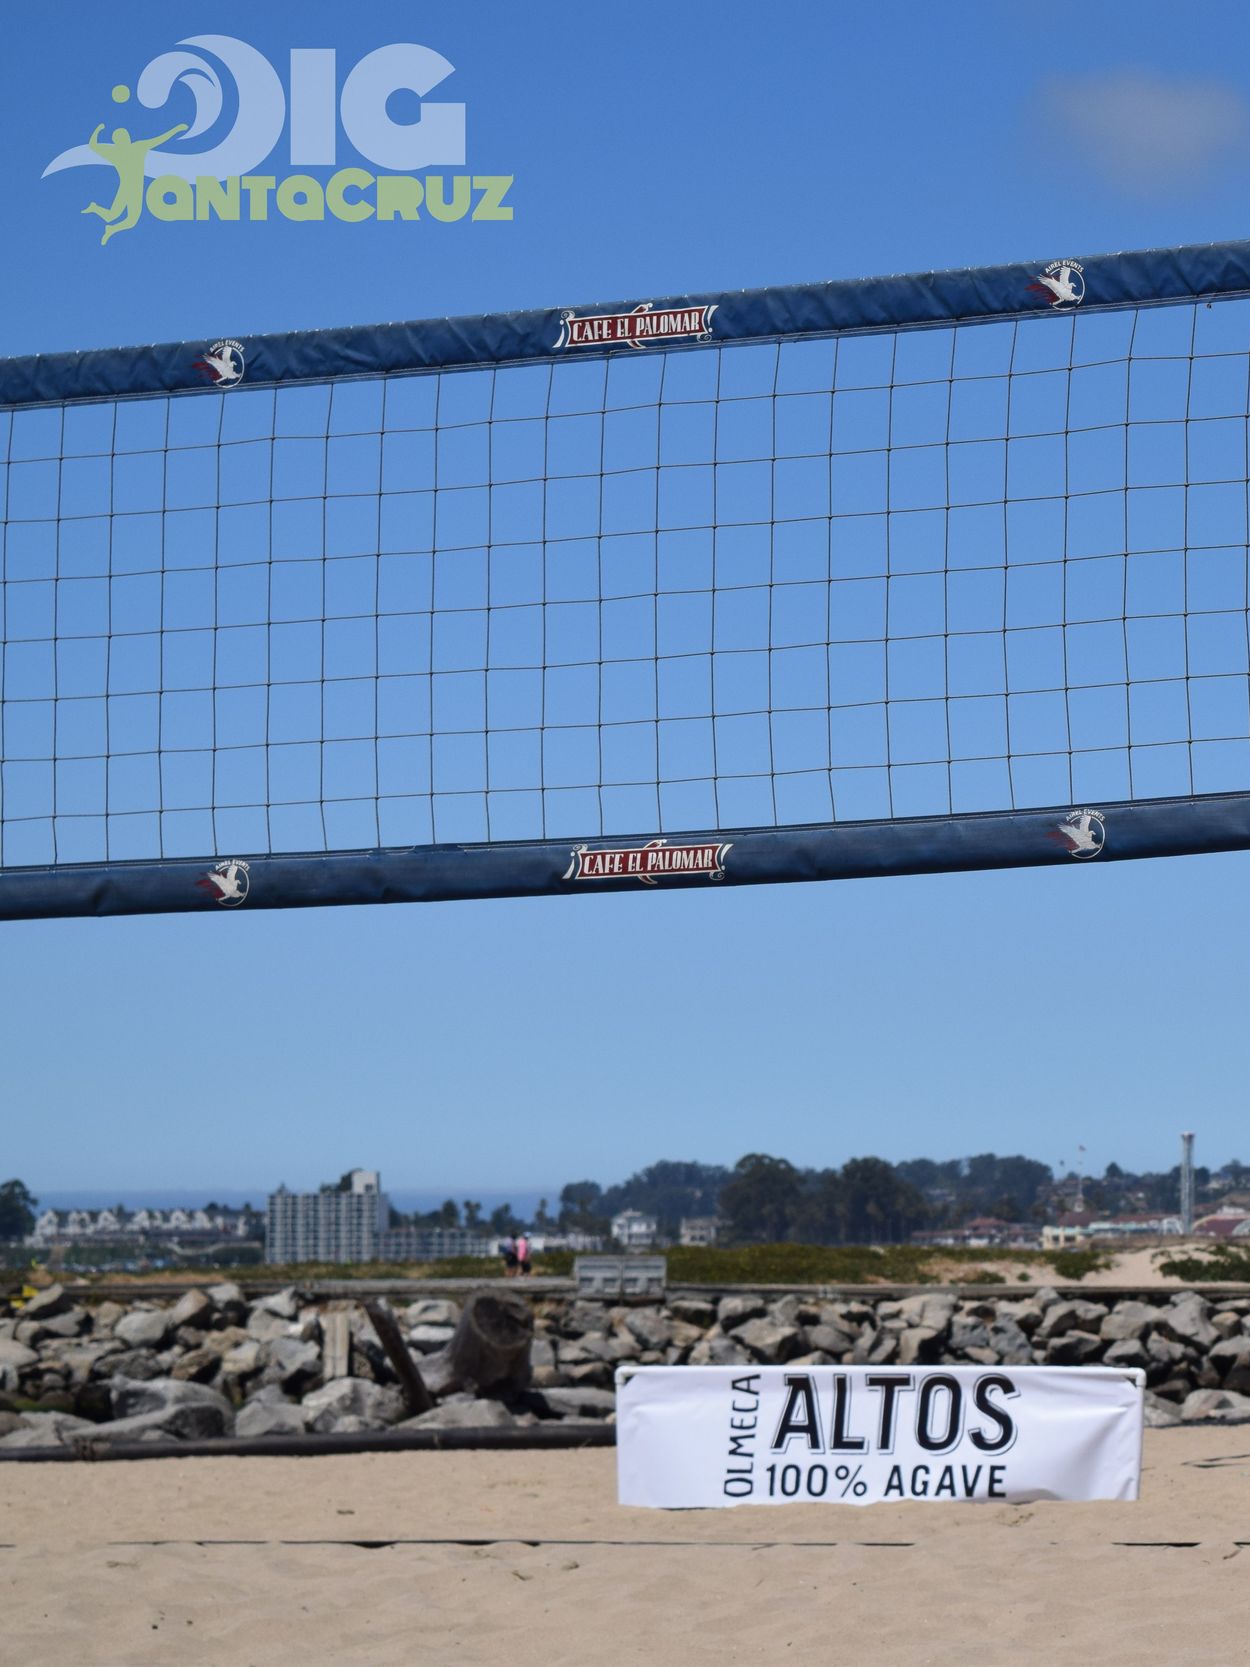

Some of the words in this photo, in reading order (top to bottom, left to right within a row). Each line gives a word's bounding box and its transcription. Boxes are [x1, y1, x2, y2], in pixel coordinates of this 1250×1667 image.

[1045, 262, 1061, 273] AIREL
[1063, 260, 1084, 273] EVENTS
[572, 319, 612, 342] CAFE
[617, 318, 632, 337] EL
[636, 311, 700, 336] PALOMAR
[584, 853, 624, 875] CAFE
[628, 852, 643, 872] EL
[647, 848, 713, 871] PALOMAR
[770, 1373, 1021, 1456] ALTOS
[723, 1374, 761, 1498] OLMECA
[766, 1464, 867, 1498] 100%
[884, 1464, 1007, 1498] AGAVE
